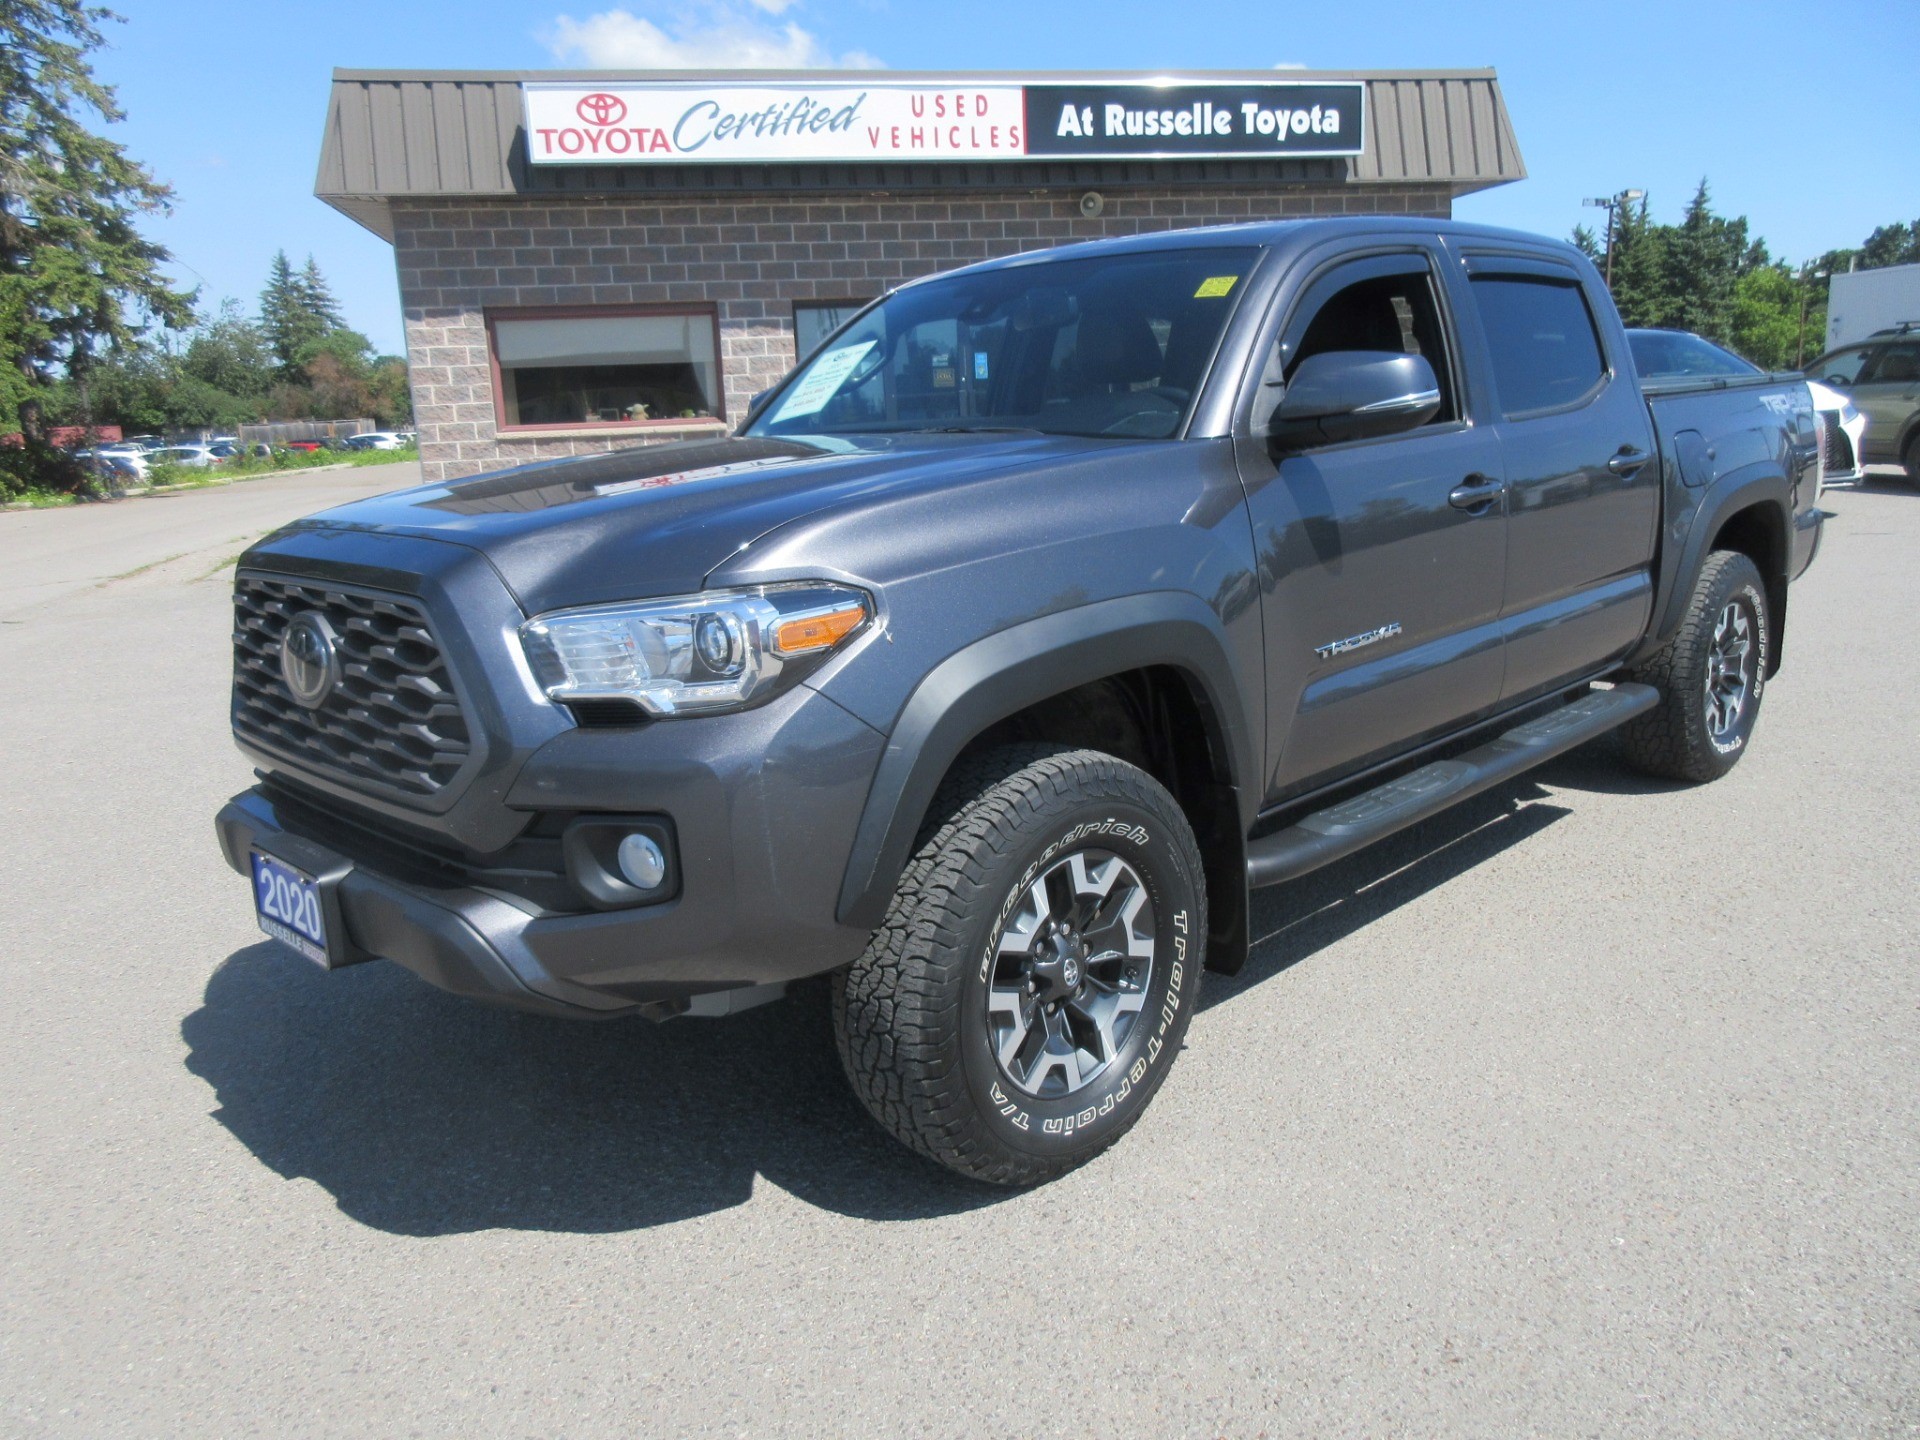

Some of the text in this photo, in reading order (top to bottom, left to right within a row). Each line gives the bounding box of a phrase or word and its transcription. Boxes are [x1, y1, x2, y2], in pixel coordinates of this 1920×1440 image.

[912, 94, 989, 117] USED
[1057, 102, 1340, 141] At Russelle Toyota
[672, 92, 867, 153] Certified
[867, 126, 1021, 149] VEHICLES
[536, 127, 672, 155] TOYOTA
[261, 867, 321, 941] 2020
